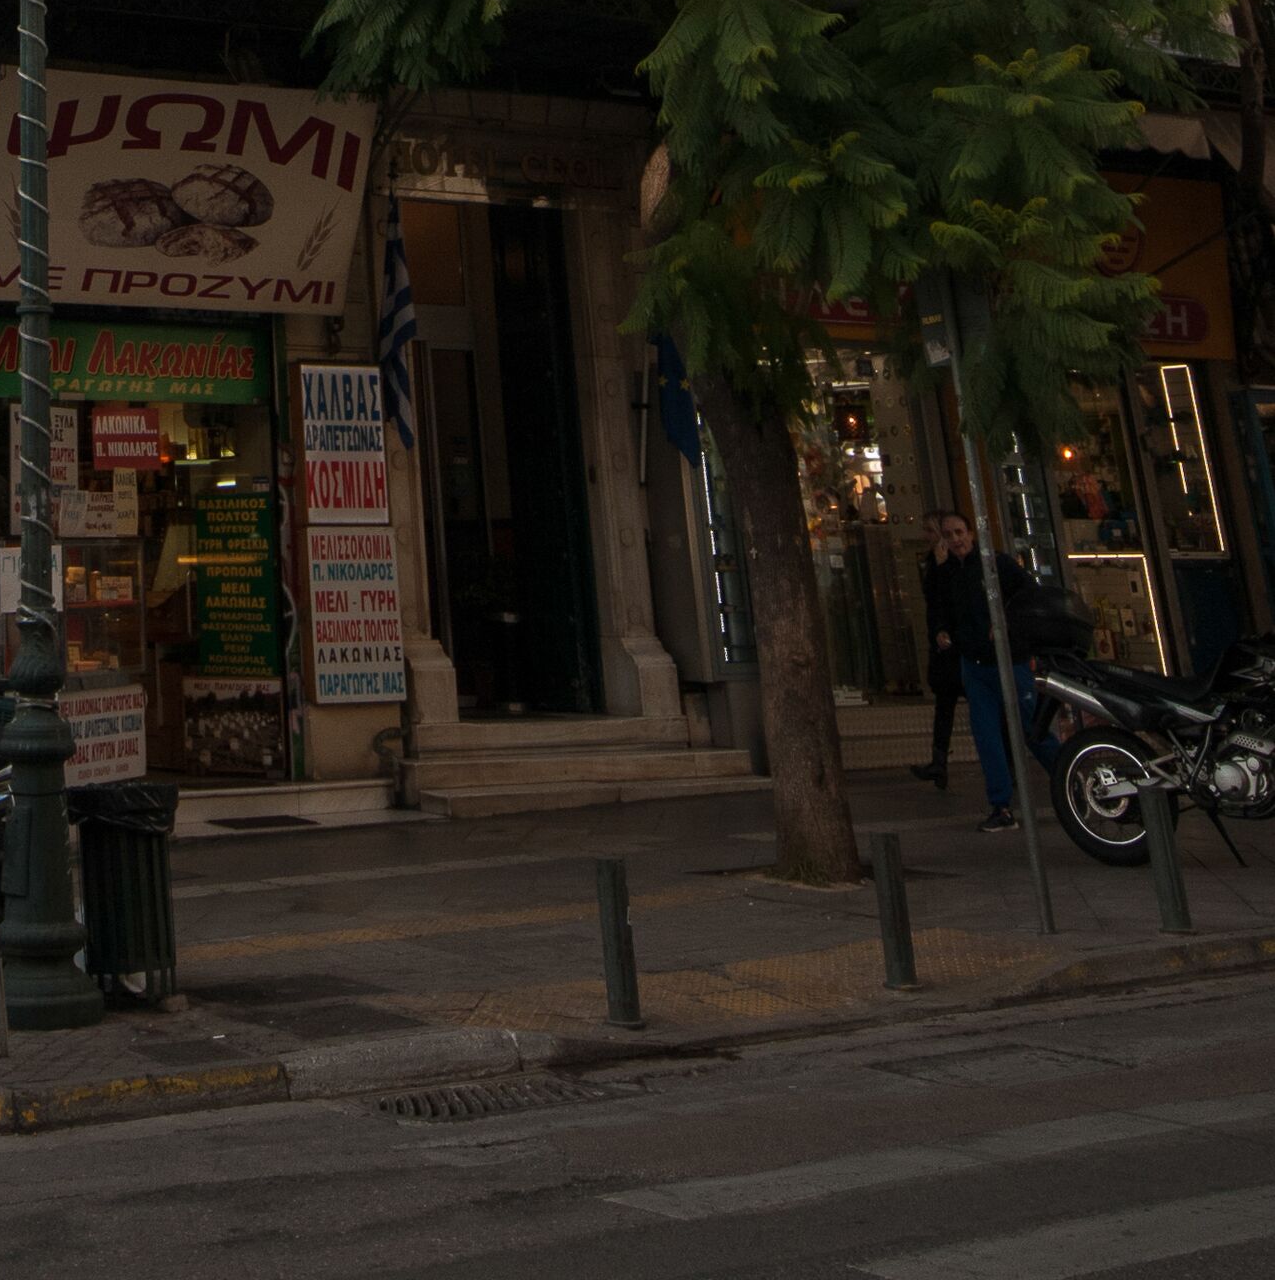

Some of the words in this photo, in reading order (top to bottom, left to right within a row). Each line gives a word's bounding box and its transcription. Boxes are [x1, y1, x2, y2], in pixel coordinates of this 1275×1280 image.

[8, 92, 361, 192] ΨΩΜΙ
[81, 268, 336, 305] ΠΡΟΖΥΜΙ
[53, 378, 155, 394] ΡΑΓΩΓΗΣ
[303, 373, 380, 422] ΧΑΛΒΑΣ
[306, 424, 383, 452] ΔΡΑΠΕΤΣΩΝΑΣ
[108, 441, 159, 457] ΝΙΚΟΛΑΡΟΣ
[306, 461, 386, 509] ΚΟΣΜΙΔΗ
[197, 498, 267, 510] ΒΑΣΙΛΙΚΟΣ
[206, 510, 259, 522] ΠΟΛΤΟΣ
[311, 535, 392, 560] ΜΕΛΙΣΣΟΚΟΜΙΑ
[206, 565, 262, 577] ΠΡΟΠΟΛΗ
[313, 563, 325, 581] Π.
[327, 563, 394, 581] ΝΙΚΟΛΑΡΟΣ
[220, 582, 251, 594] ΜΕΛΙ
[205, 596, 267, 609] ΛΑΚΩΝΙΑΣ
[315, 590, 349, 613] ΜΕΛΙ
[361, 590, 397, 612] ΓΥΡΗ
[316, 621, 361, 643] ΒΑΣΙΛΙΚΟΣ
[364, 620, 400, 641] ΠΟΛΤΟΣ
[318, 646, 402, 664] ΛΑΚΩΝΙΑΣ
[319, 673, 380, 696] ΠΑΡΑΓΩΓΗΣ
[383, 672, 404, 694] ΜΑΣ
